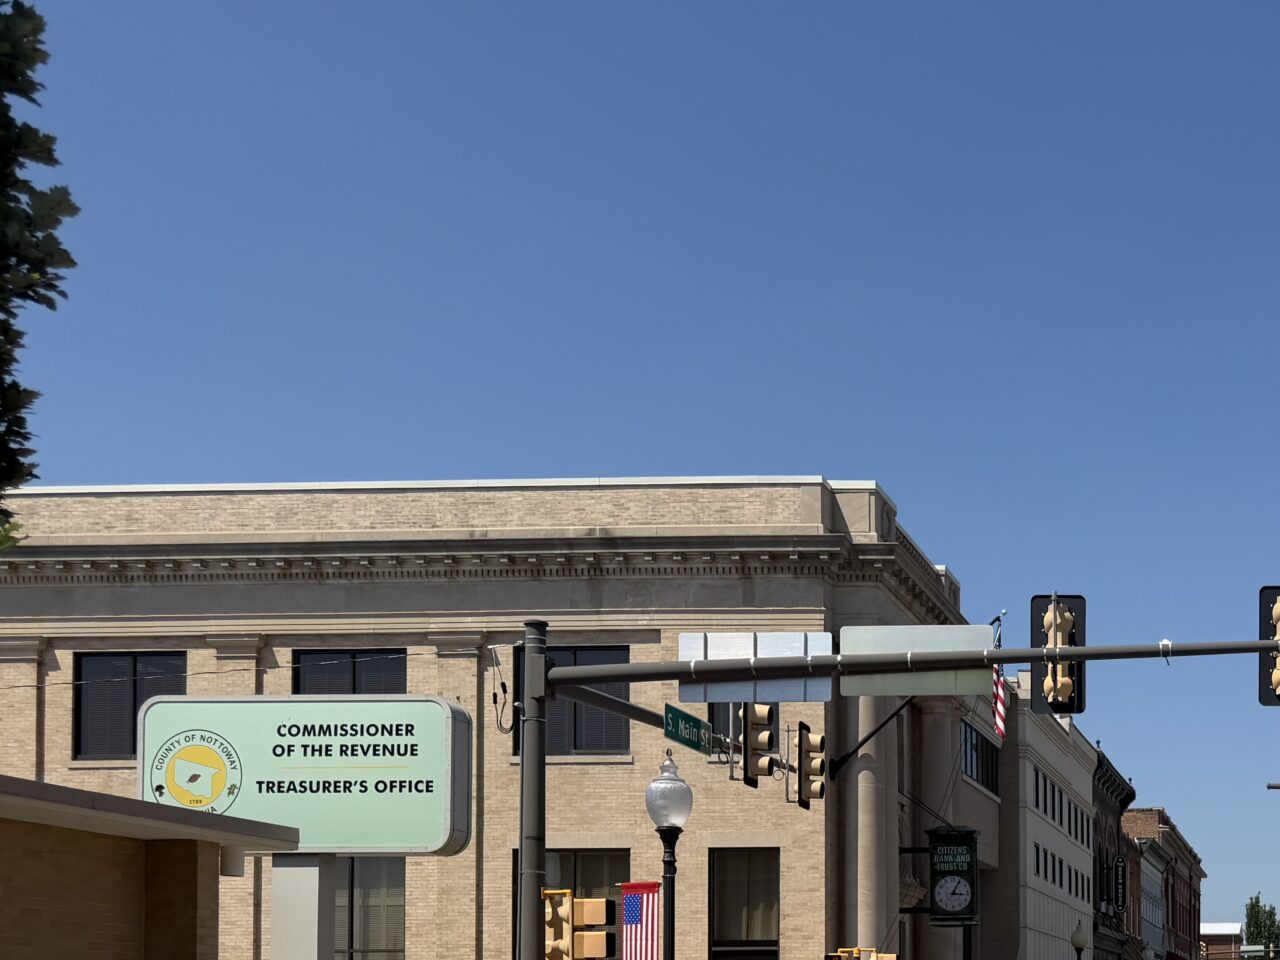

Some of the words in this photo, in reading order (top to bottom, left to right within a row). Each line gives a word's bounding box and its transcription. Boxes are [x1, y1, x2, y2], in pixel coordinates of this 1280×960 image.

[276, 723, 415, 738] COMMISSIONER
[667, 713, 675, 733] S.
[678, 718, 698, 743] Main
[700, 729, 709, 747] St
[155, 738, 182, 771] COUNTY
[184, 734, 197, 743] OF
[199, 734, 238, 771] NOTTOWAY
[271, 744, 296, 758] OF
[300, 744, 333, 758] THE
[339, 743, 419, 758] REVENUE
[255, 780, 369, 794] TREASURER’S
[374, 779, 434, 794] OFFICE
[938, 846, 967, 854] CITIZENS
[934, 854, 953, 862] BANK
[956, 854, 971, 862] AND
[936, 862, 957, 871] TRUST
